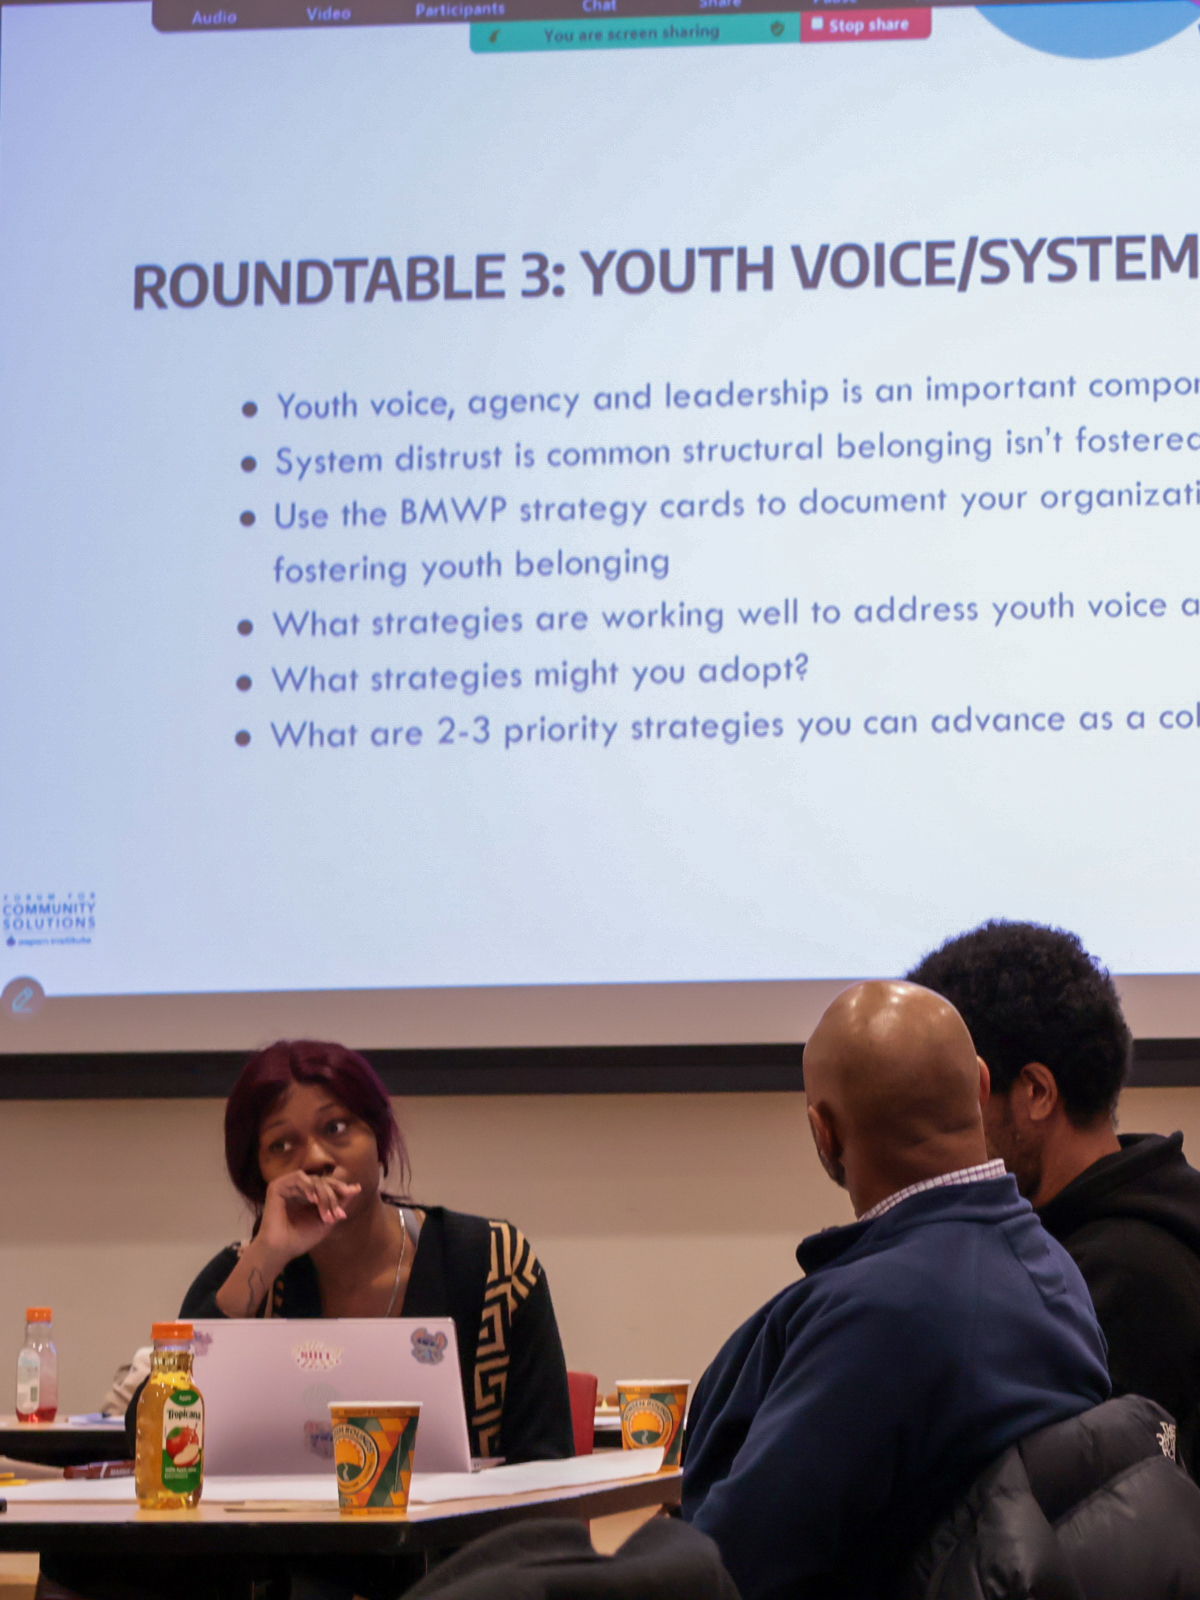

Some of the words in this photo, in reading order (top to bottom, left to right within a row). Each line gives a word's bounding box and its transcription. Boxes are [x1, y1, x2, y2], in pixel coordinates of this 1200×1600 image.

[191, 10, 237, 25] Audio
[306, 6, 351, 21] Video
[415, 3, 507, 18] Participants
[582, 0, 618, 13] Chat
[545, 29, 574, 43] You
[579, 30, 603, 41] are
[608, 27, 658, 41] screen
[662, 24, 720, 41] sharing
[829, 19, 865, 35] Stop
[868, 17, 910, 31] share
[133, 252, 507, 312] ROUNDTABLE
[520, 250, 566, 300] 3:
[578, 244, 775, 298] YOUTH
[789, 232, 1200, 294] VOICE/SYSTEM
[276, 390, 358, 421] Youth
[369, 389, 456, 422] voice,
[467, 392, 580, 421] agency
[592, 381, 652, 412] and
[665, 377, 829, 412] leadership
[842, 377, 863, 405] is
[874, 382, 913, 404] an
[925, 374, 1077, 408] important
[275, 446, 383, 482] System
[394, 443, 503, 473] distrust
[514, 441, 536, 469] is
[546, 444, 671, 469] common
[682, 432, 823, 465] structural
[836, 430, 992, 465] belonging
[1005, 425, 1063, 456] isn't
[274, 501, 329, 531] Use
[340, 499, 388, 528] the
[400, 494, 508, 526] BMWP
[519, 497, 648, 528] strategy
[659, 489, 745, 520] cards
[756, 492, 787, 517] to
[798, 486, 948, 516] document
[960, 490, 1028, 518] your
[273, 554, 407, 588] fostering
[421, 549, 503, 587] youth
[515, 547, 670, 583] belonging
[272, 609, 361, 638] What
[371, 605, 524, 641] strategies
[535, 609, 589, 633] are
[601, 599, 724, 635] working
[737, 597, 799, 627] well
[810, 601, 842, 625] to
[853, 594, 979, 625] address
[991, 591, 1075, 628] youth
[1087, 590, 1168, 619] voice
[271, 665, 359, 694] What
[370, 661, 523, 697] strategies
[534, 657, 620, 694] might
[631, 663, 686, 693] you
[697, 651, 809, 690] adopt?
[269, 720, 358, 749] What
[369, 725, 424, 748] are
[437, 714, 491, 745] 2-3
[504, 713, 619, 751] priority
[630, 710, 785, 746] strategies
[796, 716, 852, 744] you
[862, 714, 918, 736] can
[930, 704, 1066, 735] advance
[1078, 710, 1114, 732] as
[1125, 710, 1146, 731] a
[3, 902, 96, 916] COMMUNITY
[3, 916, 96, 931] SOLUTIONS
[167, 1406, 201, 1420] Tropicana
